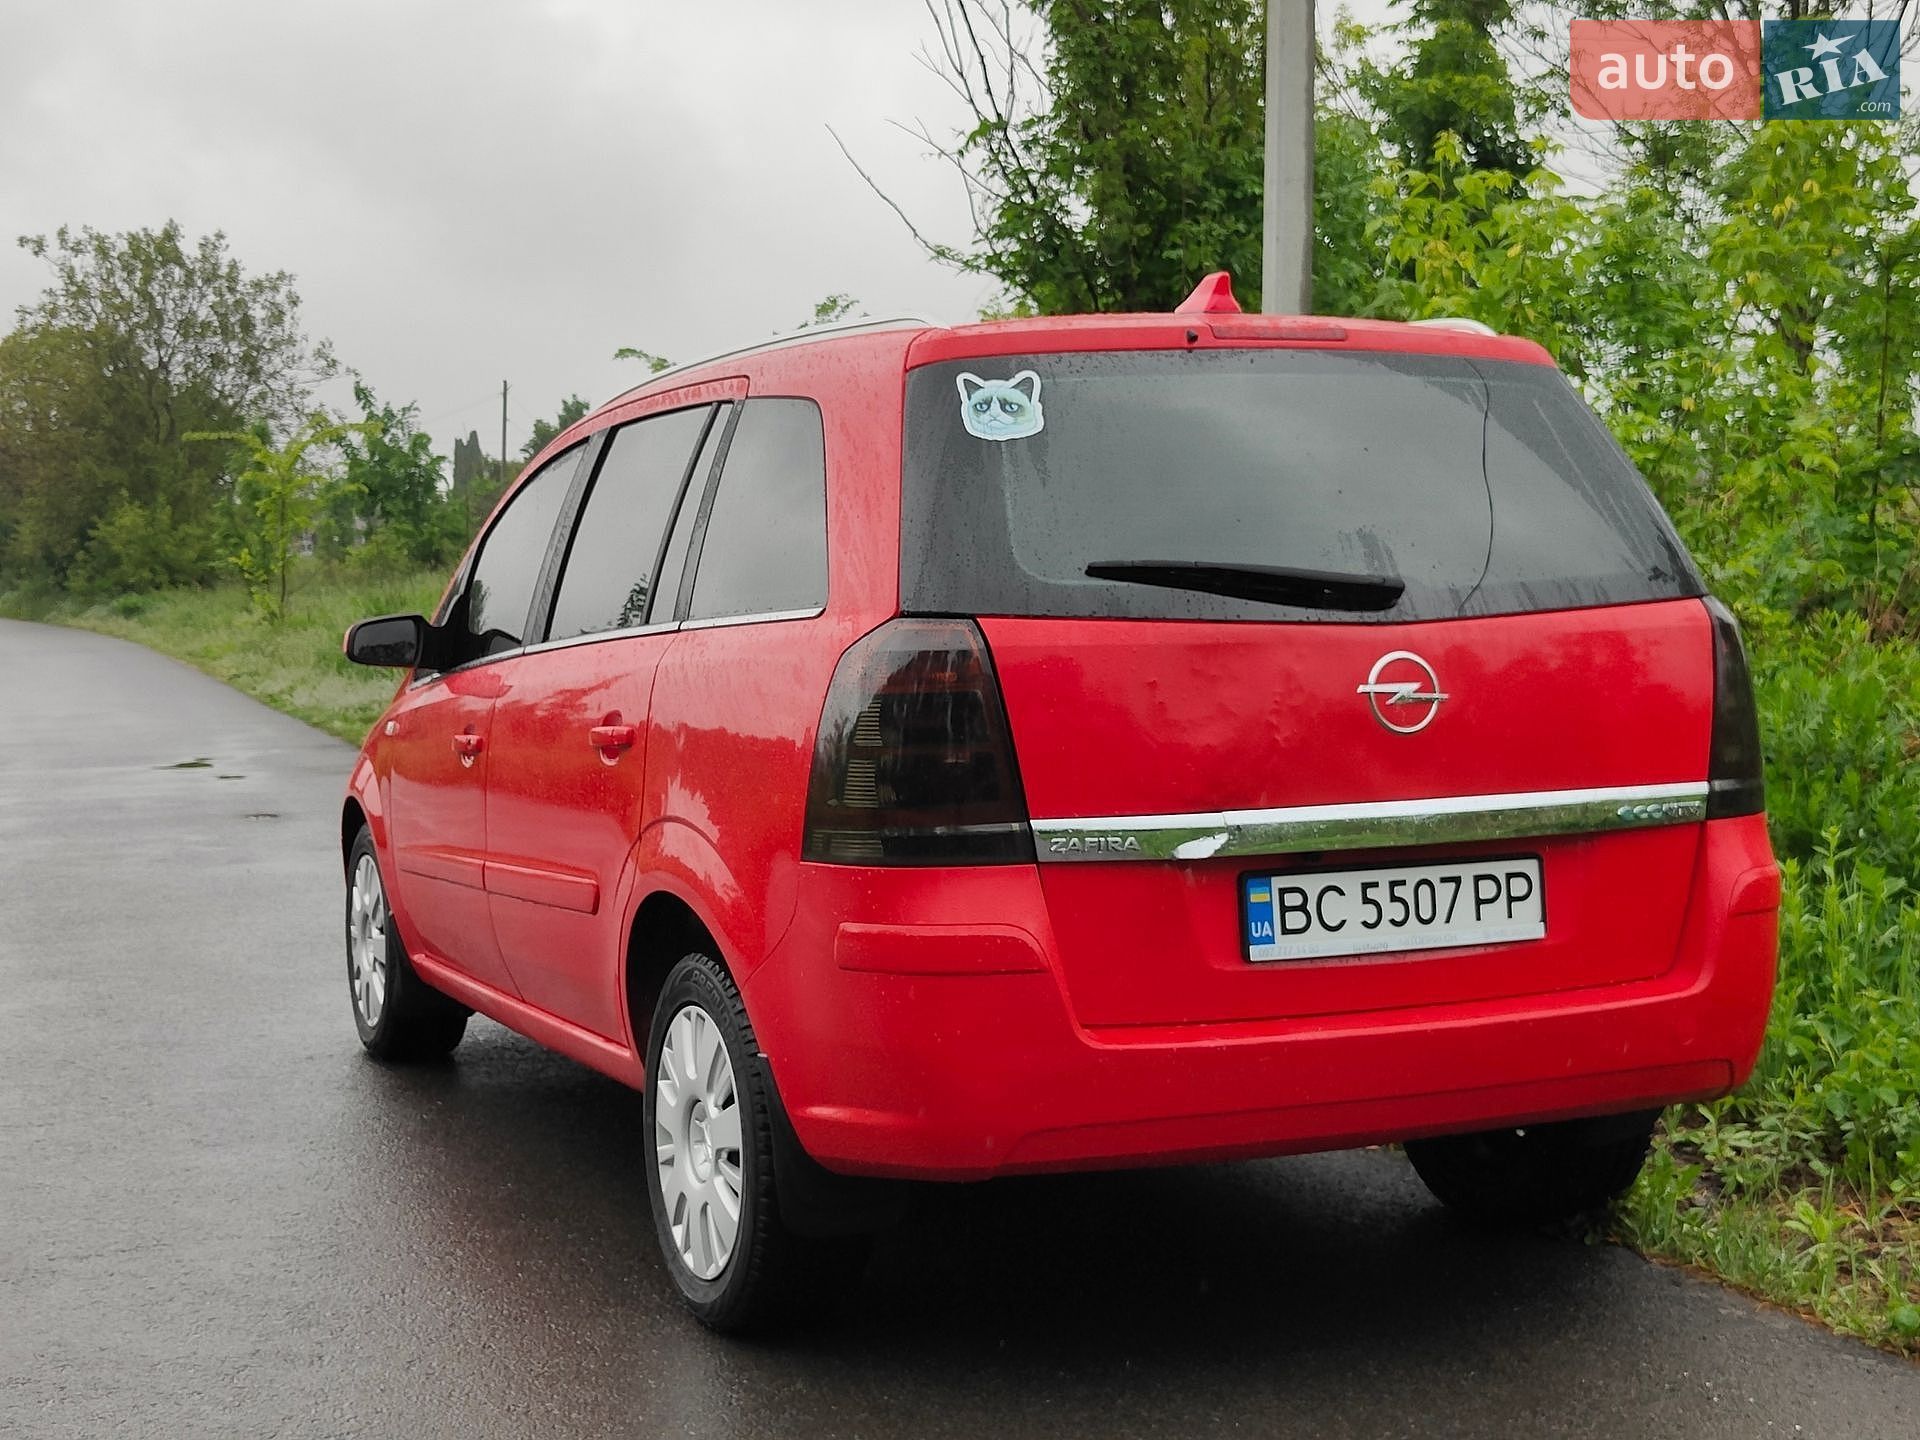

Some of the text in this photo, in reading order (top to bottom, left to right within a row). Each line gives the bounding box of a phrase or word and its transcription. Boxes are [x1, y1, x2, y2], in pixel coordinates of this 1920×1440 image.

[1050, 836, 1141, 854] ZAFIRA
[1278, 871, 1533, 936] BC 5507 PP
[1251, 920, 1273, 938] UA
